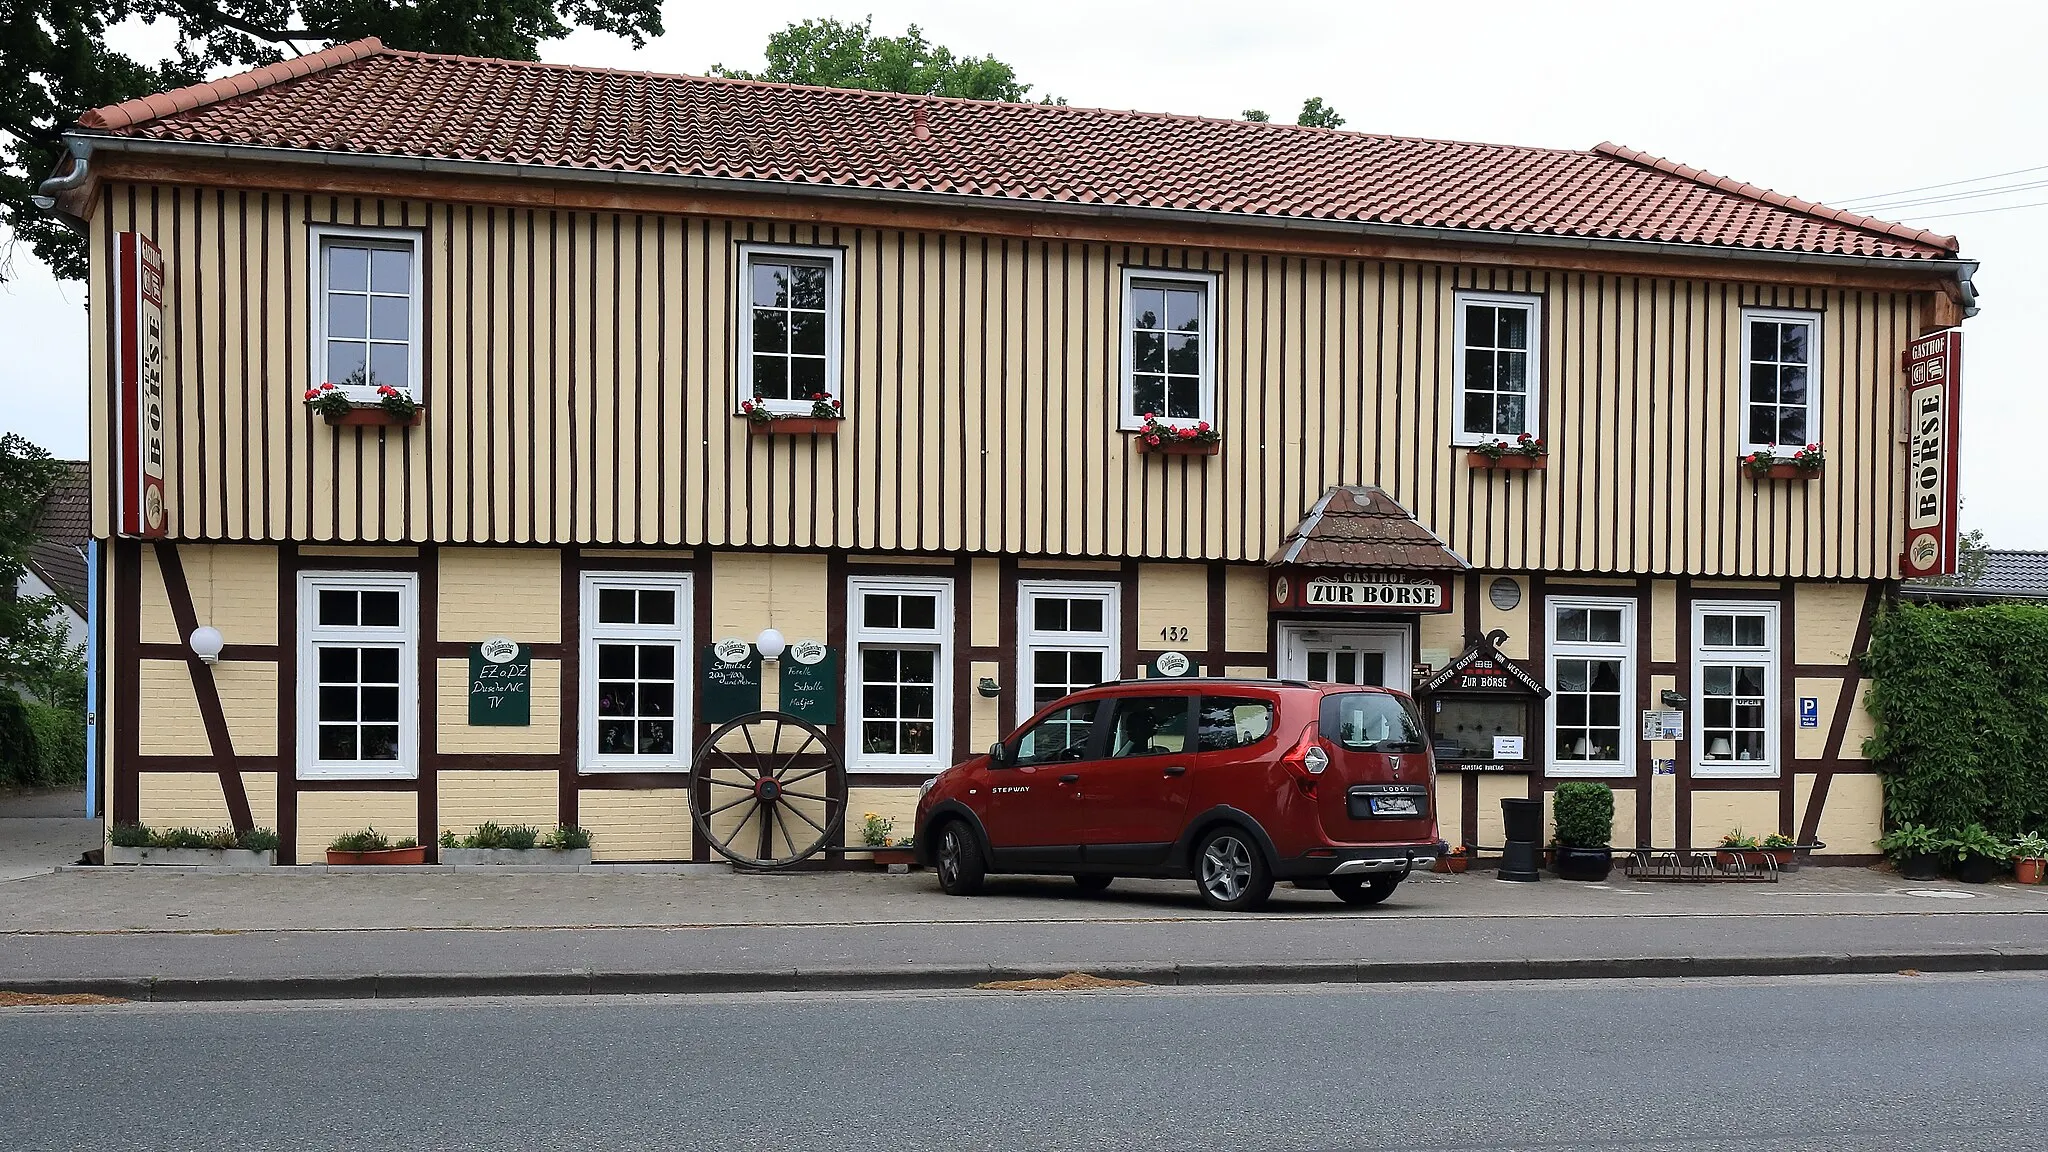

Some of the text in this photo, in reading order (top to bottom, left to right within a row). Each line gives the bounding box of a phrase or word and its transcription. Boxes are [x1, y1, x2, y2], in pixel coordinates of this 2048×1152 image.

[1912, 337, 1945, 360] GASTHOF
[148, 315, 161, 467] BÖRSE
[1913, 434, 1921, 469] ZUR
[1916, 394, 1940, 519] BÖRSE
[1343, 572, 1407, 583] GASTHOF
[1313, 584, 1436, 604] ZUR BÖRSE
[1160, 626, 1189, 641] 132
[1456, 649, 1479, 670] GASTHOF
[480, 664, 499, 679] EZ
[1481, 675, 1507, 688] BÖRSE
[488, 695, 504, 709] TV
[1804, 699, 1815, 715] P
[992, 786, 1030, 794] STEPWAY
